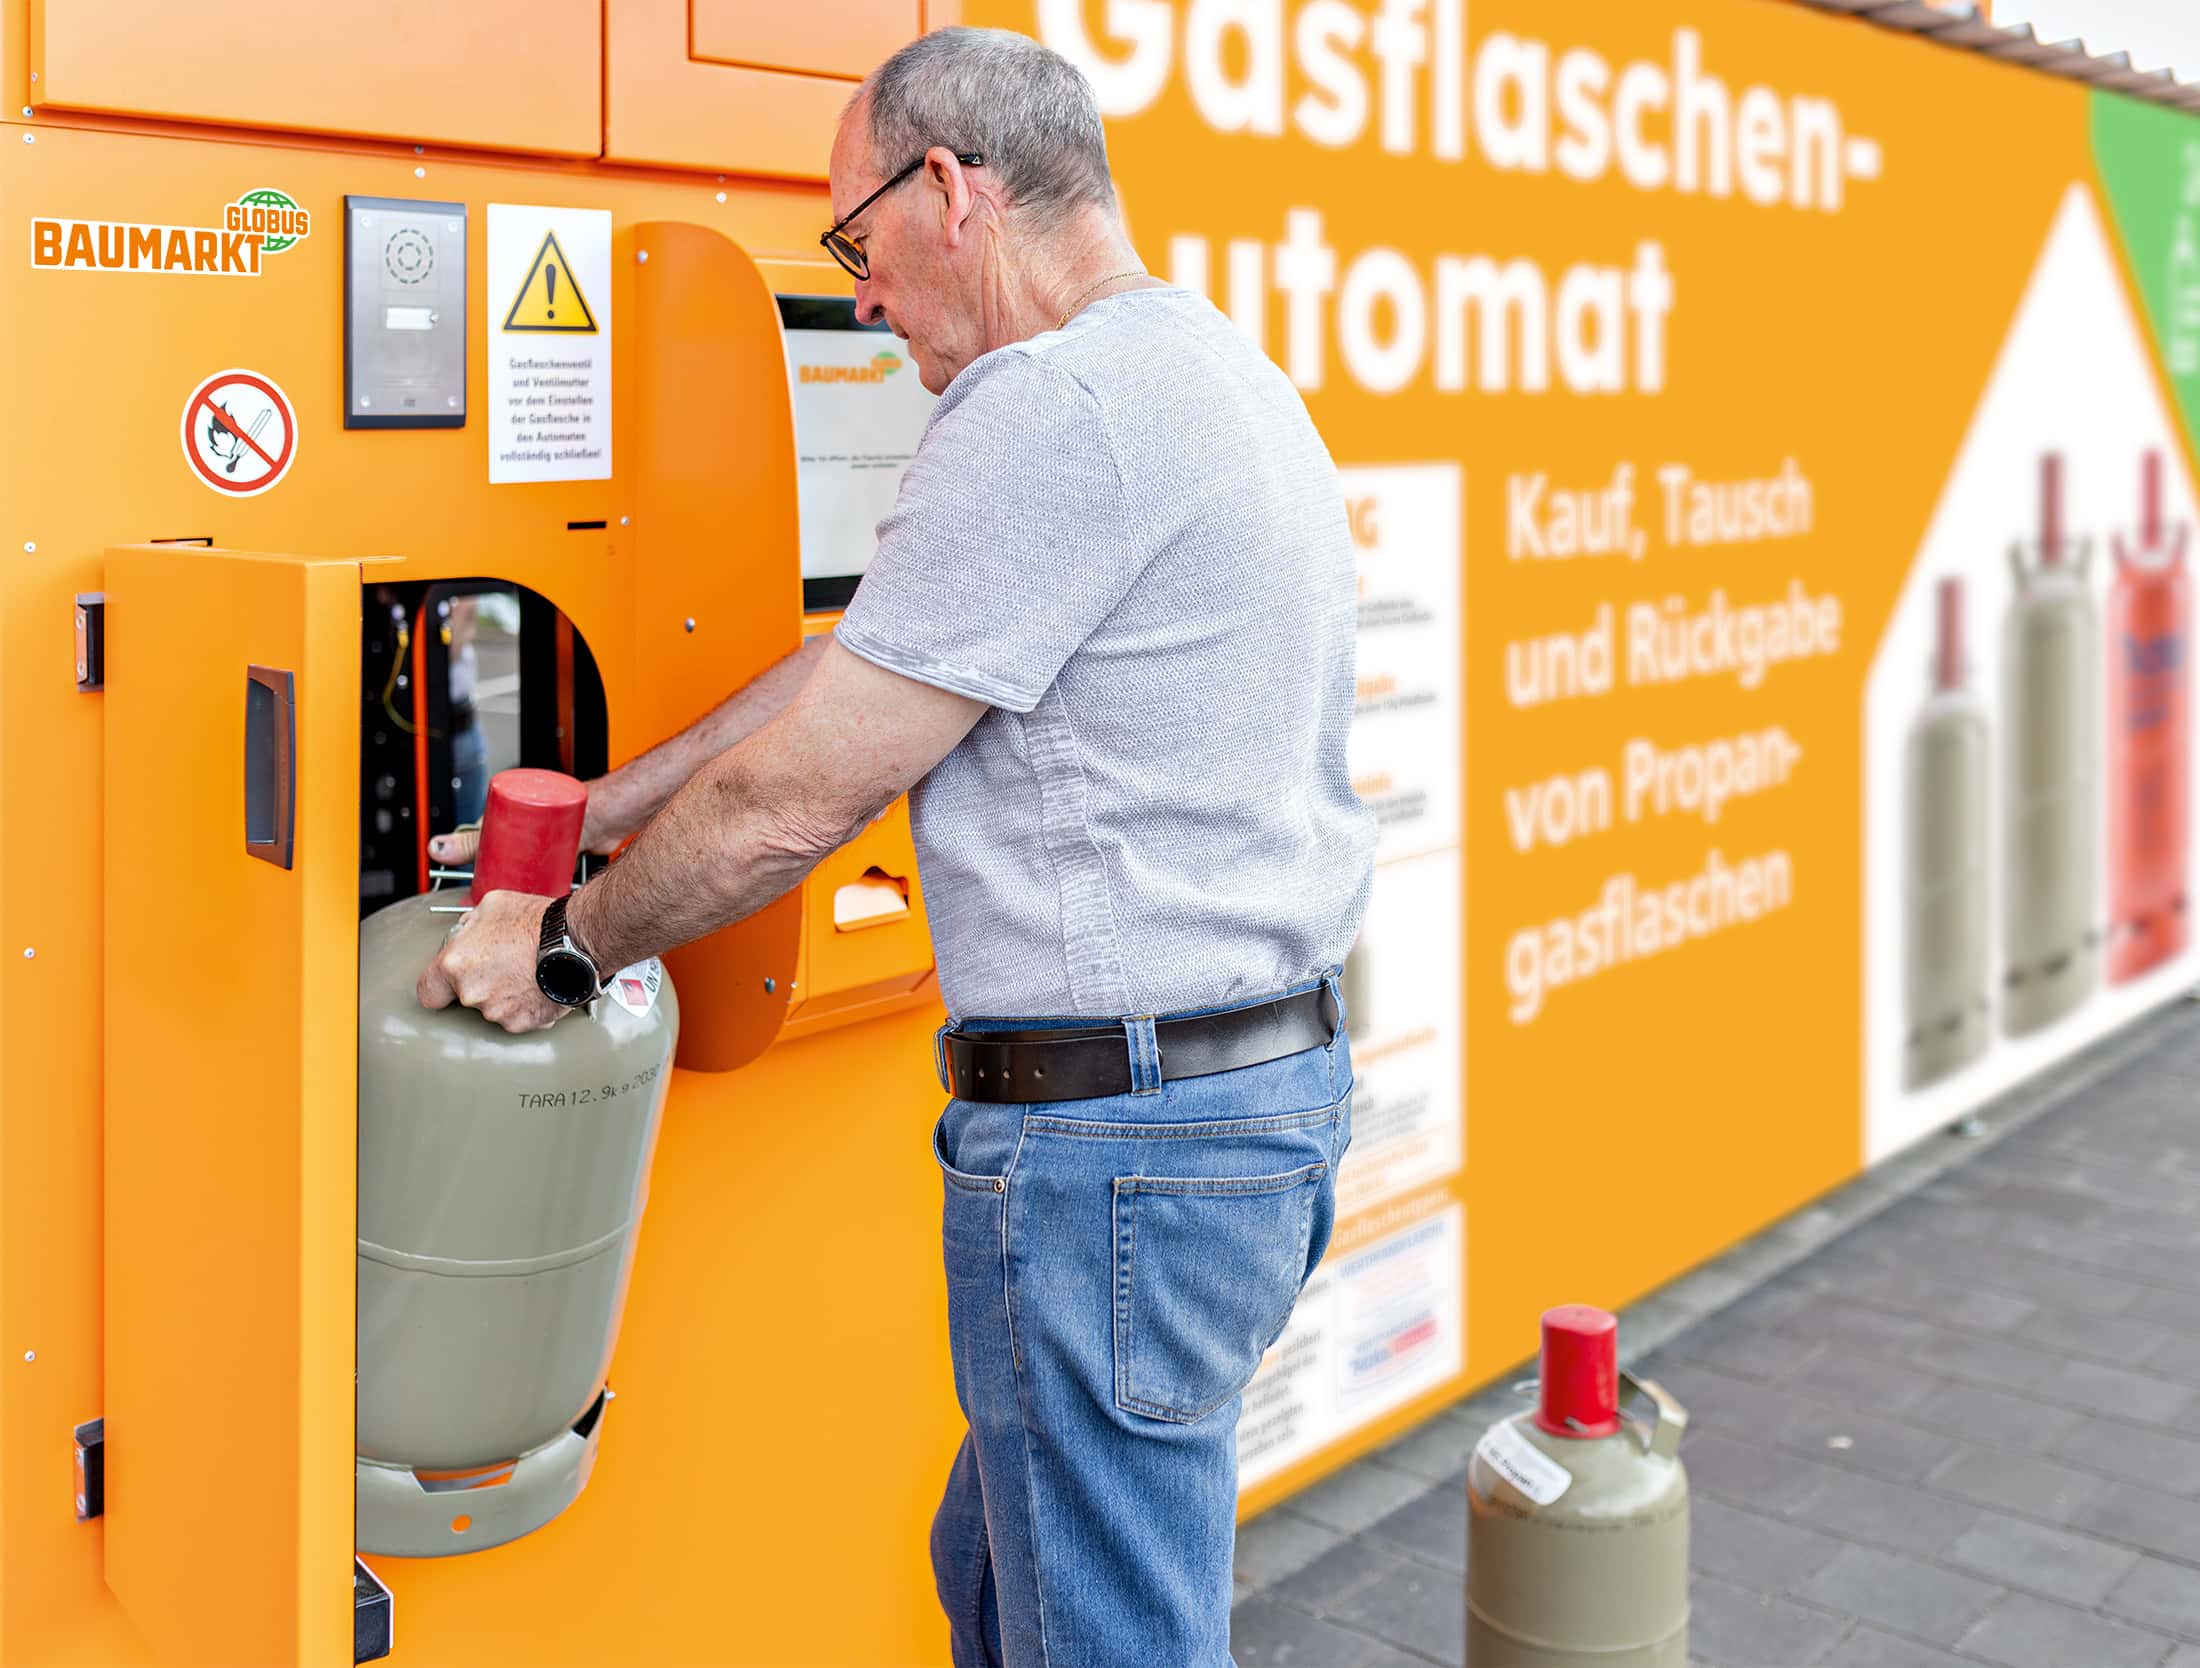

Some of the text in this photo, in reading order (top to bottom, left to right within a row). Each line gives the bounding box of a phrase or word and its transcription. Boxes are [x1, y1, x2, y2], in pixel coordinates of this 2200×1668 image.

[1037, 0, 1882, 211] Gasflaschen-
[34, 221, 264, 273] BAUMARKT
[226, 205, 308, 236] GLOBUS
[1168, 208, 1673, 394] utomat
[1508, 456, 1813, 561] Kauf, Tausch
[1506, 578, 1840, 709] und Rückgabe
[1505, 725, 1801, 852] von Propan-
[1506, 848, 1793, 1025] gasflaschen
[518, 1093, 566, 1109] TARA
